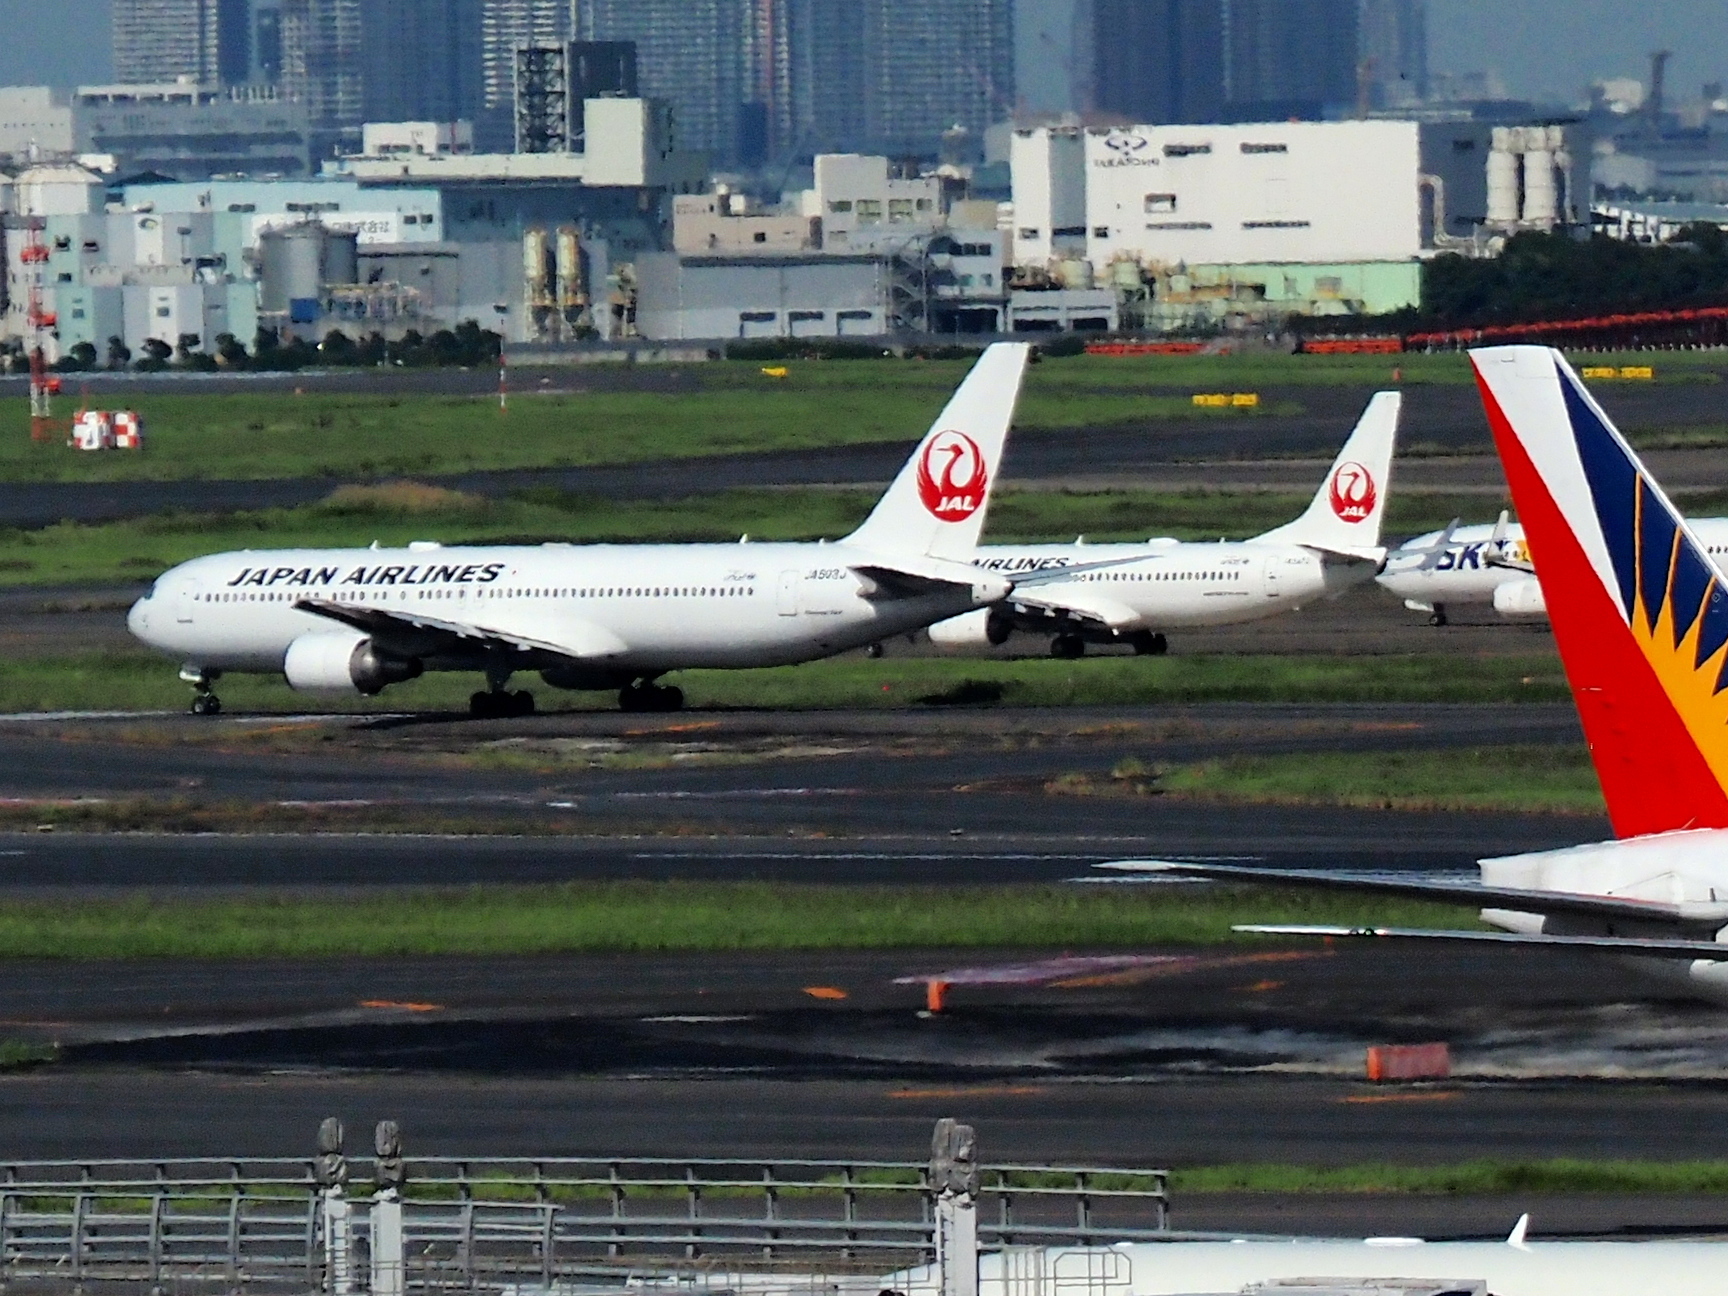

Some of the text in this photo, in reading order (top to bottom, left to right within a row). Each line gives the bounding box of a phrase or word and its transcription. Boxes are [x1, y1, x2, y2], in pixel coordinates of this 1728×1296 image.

[934, 495, 975, 512] JAL
[1338, 506, 1368, 517] JAL
[227, 564, 505, 587] JAPAN AIRLINES
